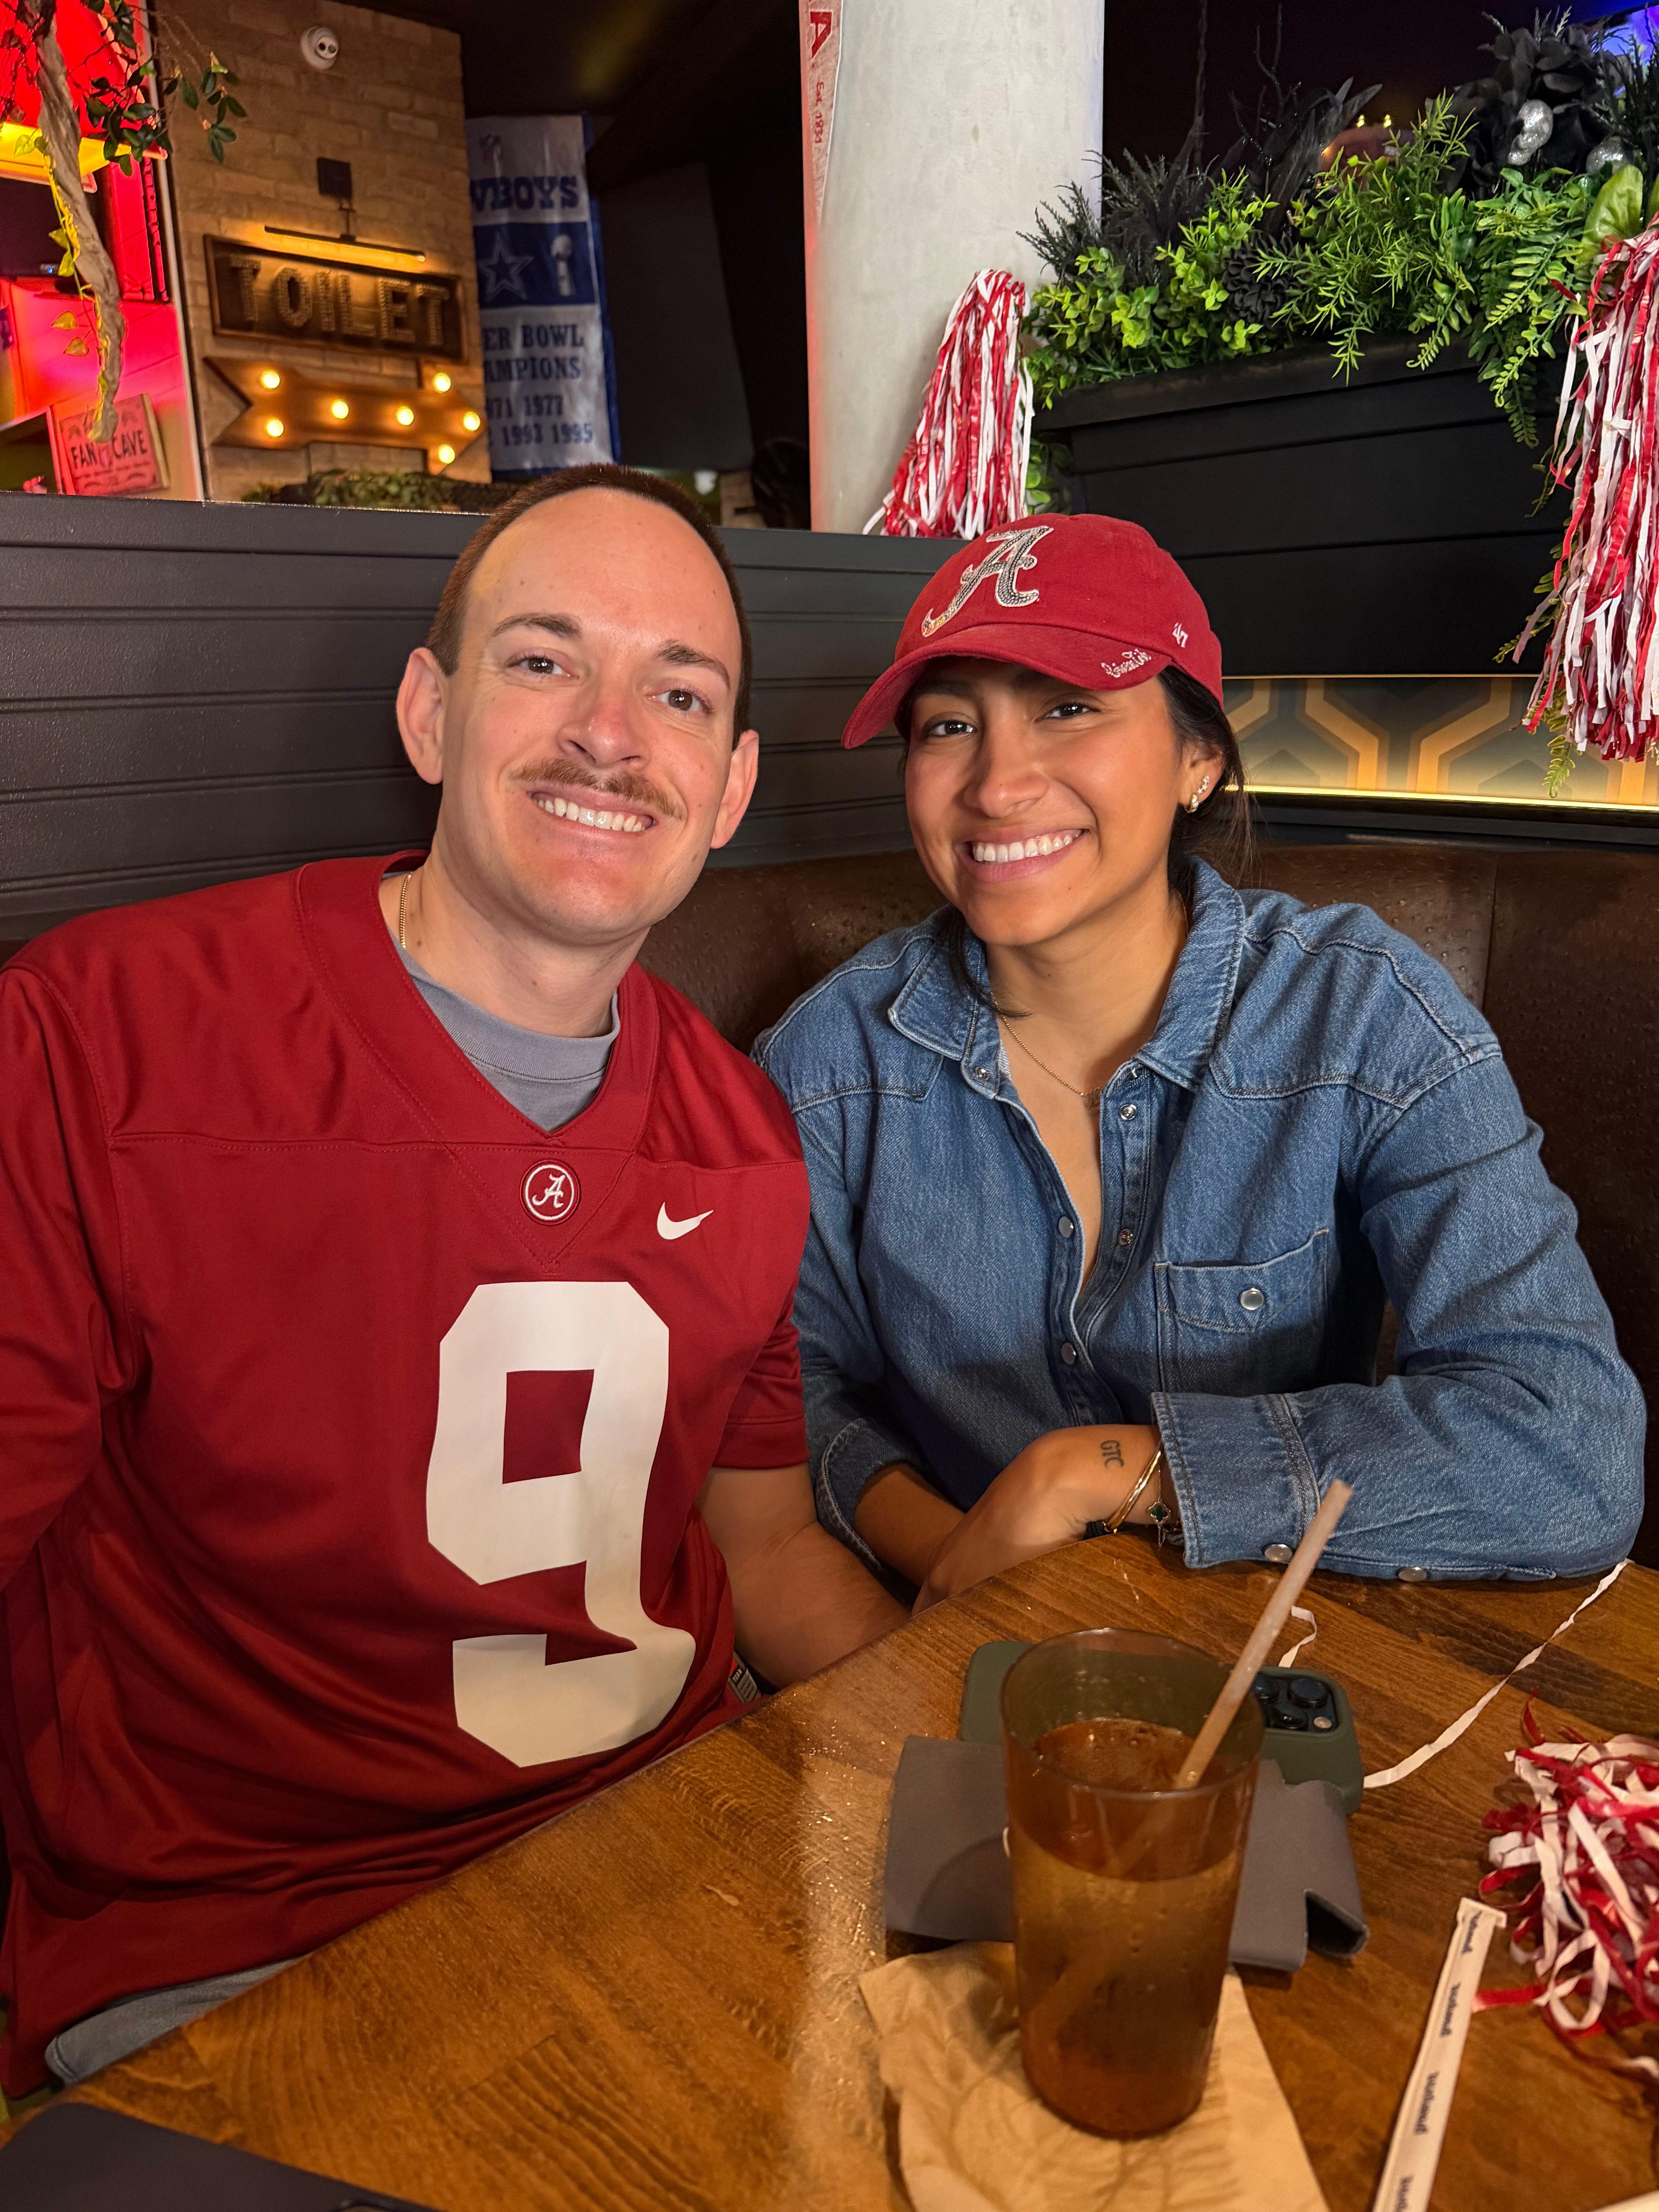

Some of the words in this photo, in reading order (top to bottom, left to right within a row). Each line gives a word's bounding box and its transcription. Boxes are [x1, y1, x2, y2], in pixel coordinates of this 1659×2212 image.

[230, 256, 450, 345] TOILET
[522, 324, 584, 348] BOWL
[524, 395, 563, 417] 1977
[112, 429, 147, 459] CAVE
[921, 525, 1054, 637] A
[532, 1174, 565, 1208] A
[426, 1281, 696, 1768] 9
